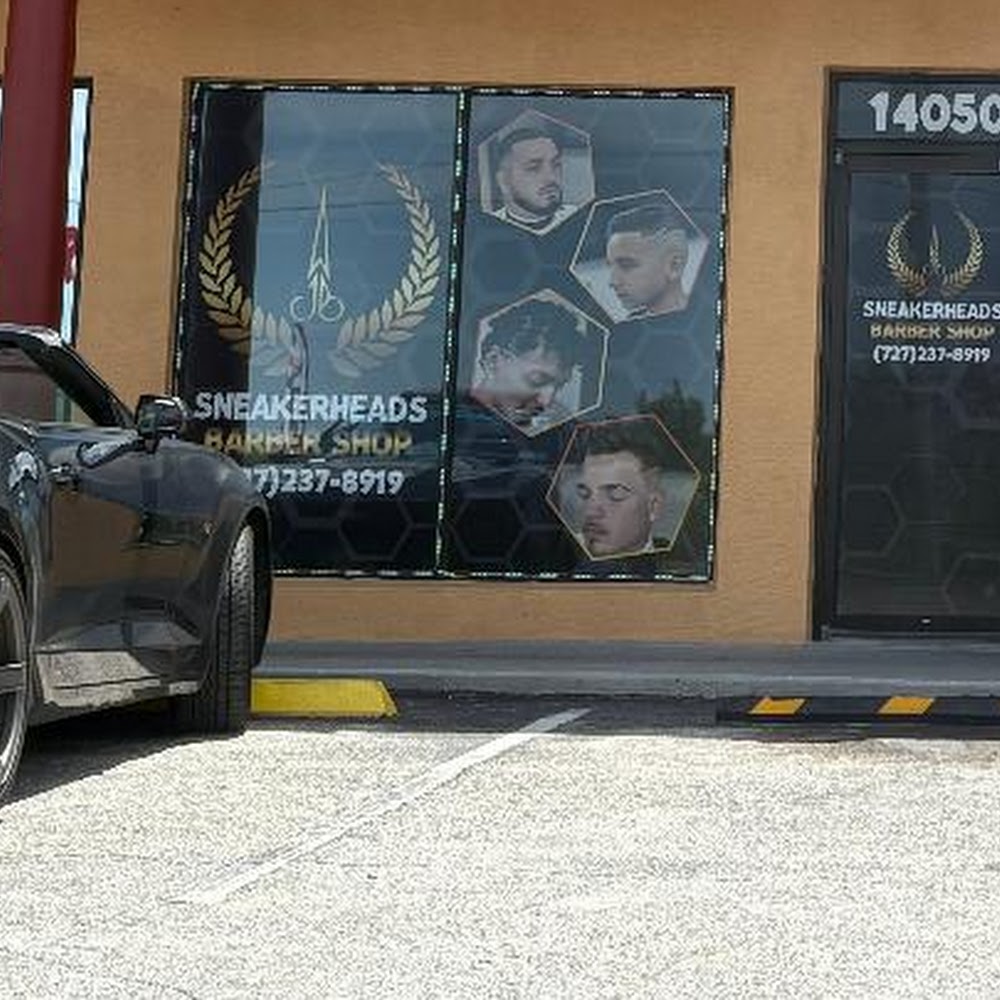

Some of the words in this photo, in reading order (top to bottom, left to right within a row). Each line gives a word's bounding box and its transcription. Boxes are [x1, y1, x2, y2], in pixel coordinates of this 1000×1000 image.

[870, 323, 942, 339] BARBER
[947, 325, 995, 340] SHOP
[873, 345, 991, 364] (727)237-8919
[194, 392, 428, 423] SNEAKERHEADS
[332, 430, 413, 456] SHOP
